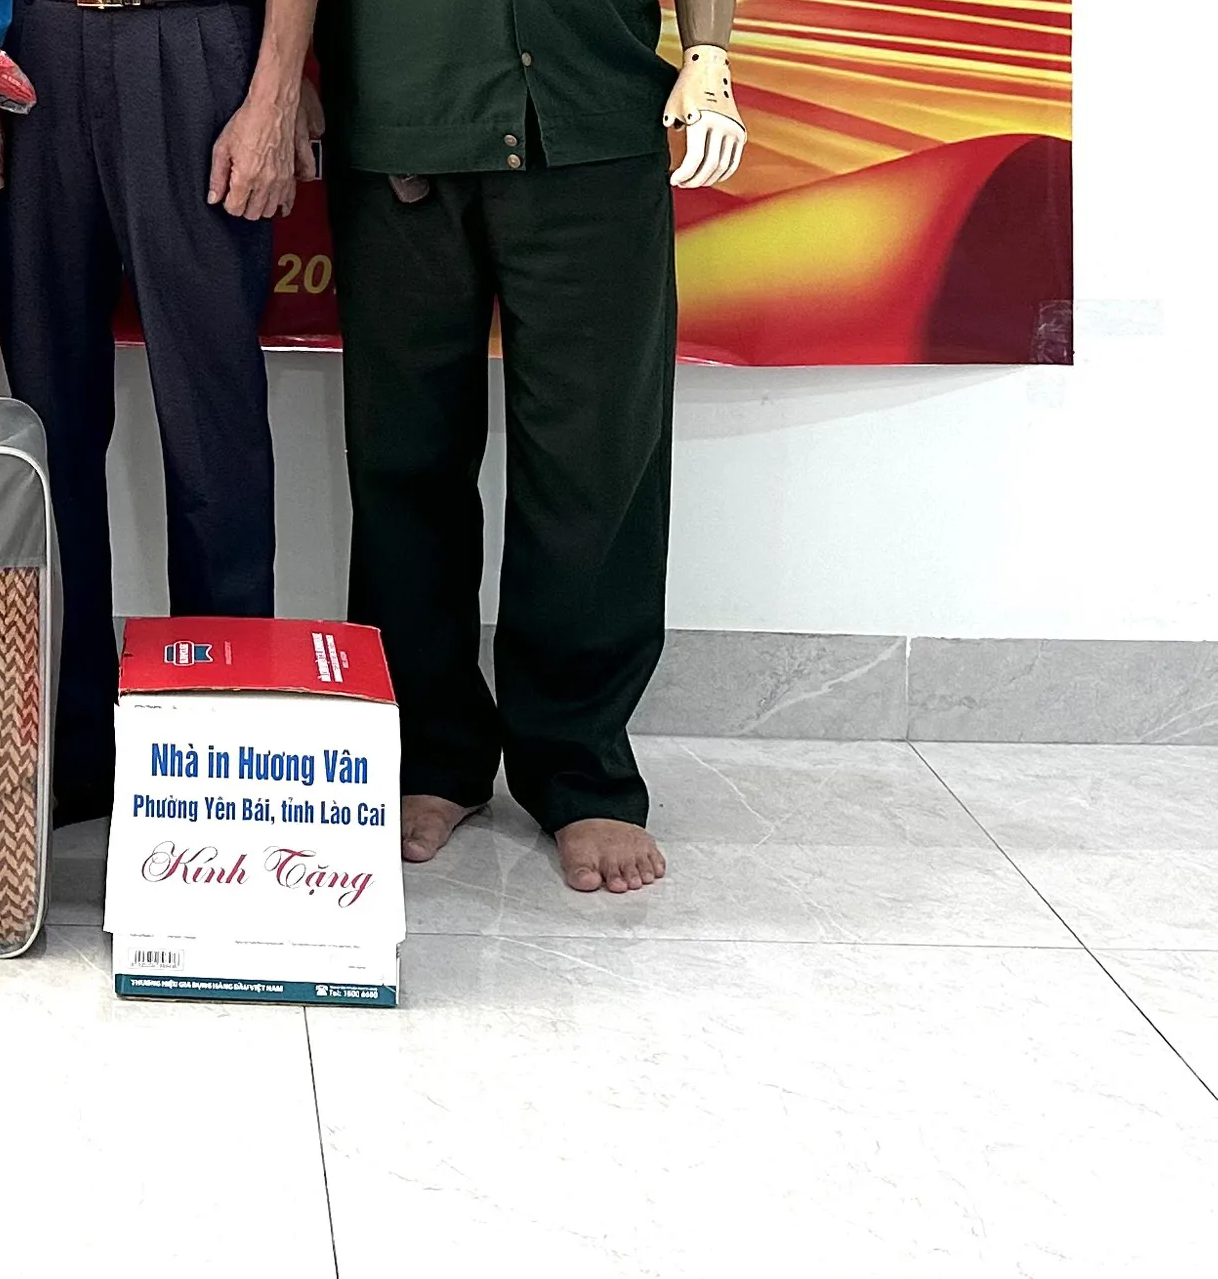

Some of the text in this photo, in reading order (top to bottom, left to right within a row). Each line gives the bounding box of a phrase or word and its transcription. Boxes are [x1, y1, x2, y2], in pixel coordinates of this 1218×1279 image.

[273, 253, 337, 295] 20
[151, 742, 368, 786] Nhà in Hương Vân
[132, 794, 386, 827] Phường Yên Bái, tỉnh Lào Cai
[263, 845, 376, 909] Tặng
